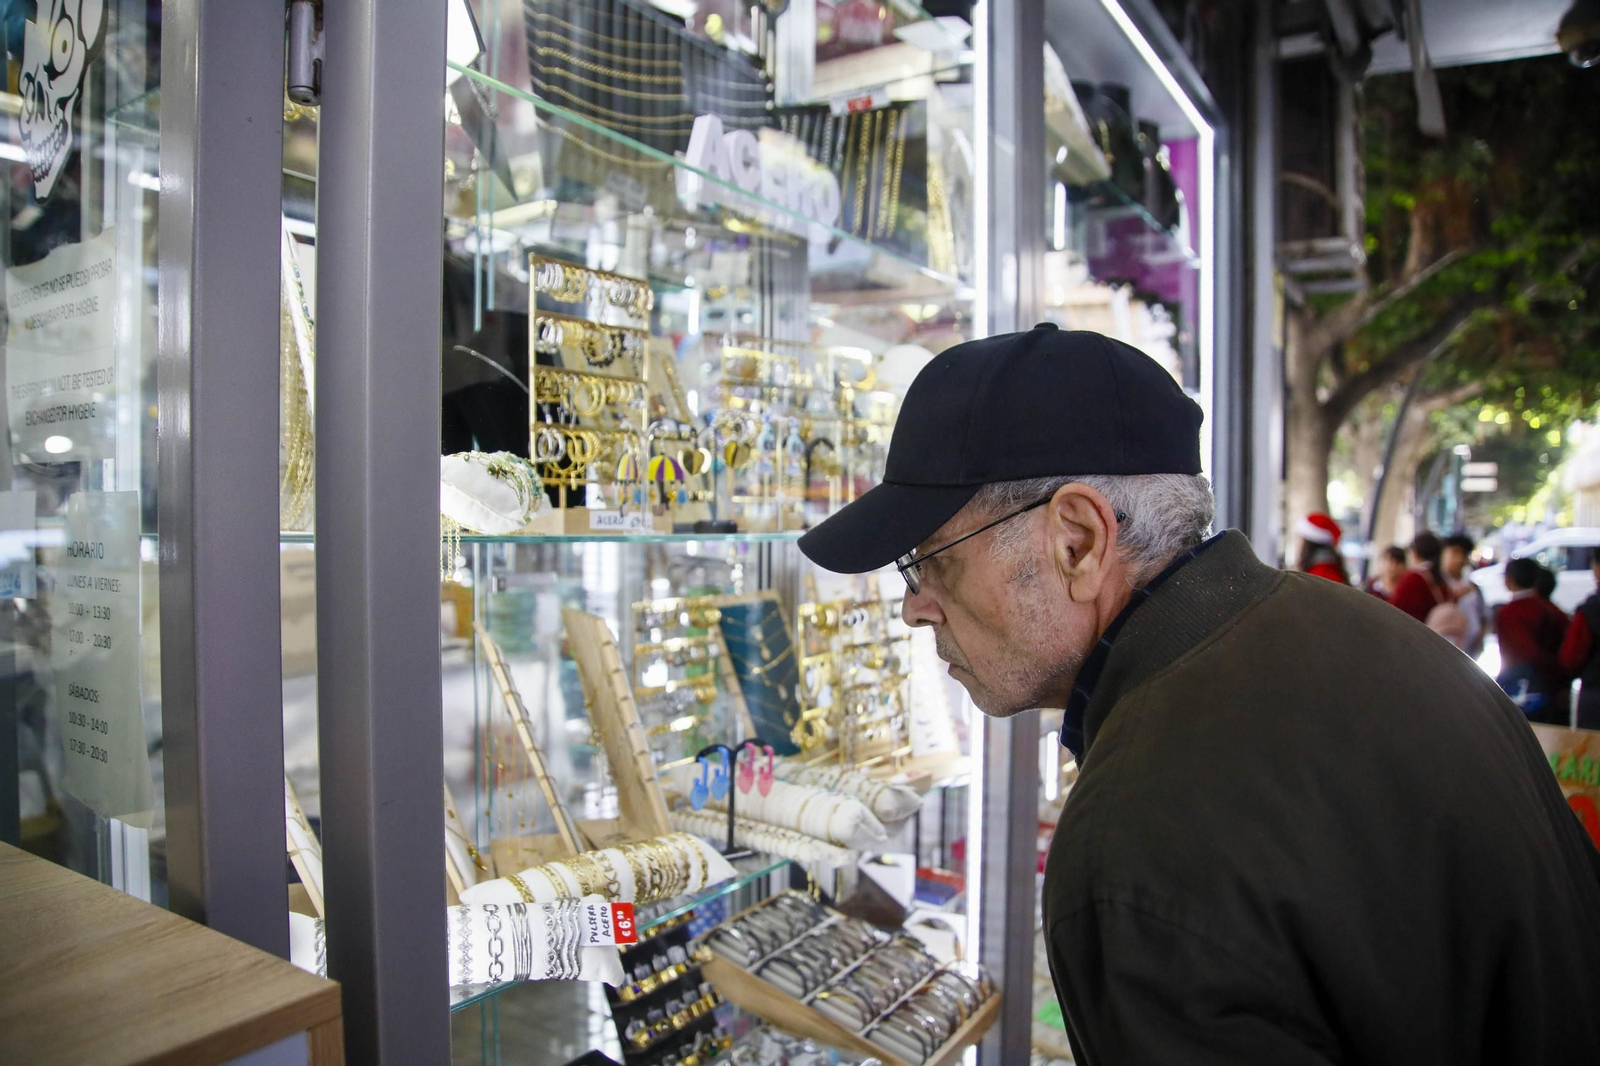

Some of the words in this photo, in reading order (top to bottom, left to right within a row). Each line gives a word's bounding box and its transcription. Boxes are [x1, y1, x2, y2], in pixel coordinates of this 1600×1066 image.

[72, 373, 81, 390] BE
[83, 368, 106, 388] TESTED
[56, 404, 67, 422] FOR
[67, 541, 104, 560] HORARIO
[67, 575, 87, 589] LUNES
[87, 576, 93, 590] A
[94, 577, 121, 593] VIERNES:
[93, 605, 111, 620] 13:30
[69, 629, 84, 644] 17:00
[93, 633, 111, 649] 20:30
[69, 681, 100, 703] SÁBADOS:
[69, 711, 86, 727] 10:30
[91, 718, 108, 735] 14:00
[70, 738, 86, 755] 17:30
[91, 745, 108, 764] 20:30
[587, 904, 600, 943] PULSERA
[600, 905, 612, 937] ACERO
